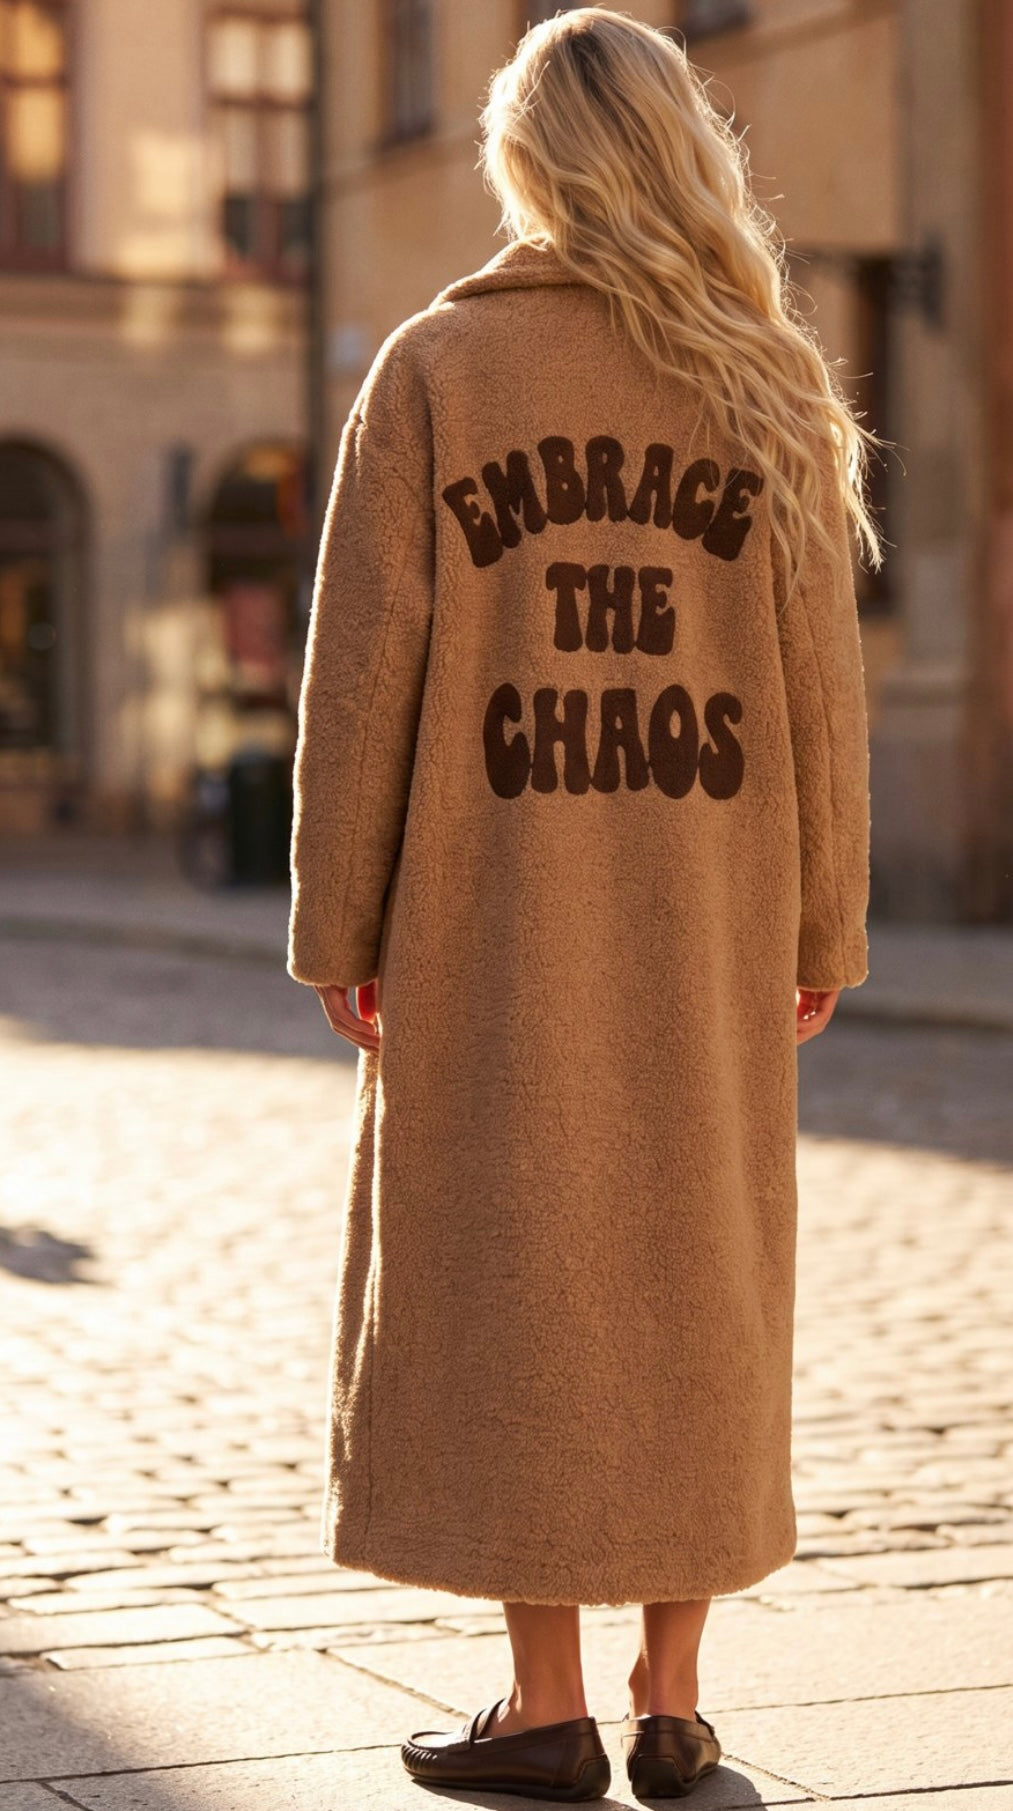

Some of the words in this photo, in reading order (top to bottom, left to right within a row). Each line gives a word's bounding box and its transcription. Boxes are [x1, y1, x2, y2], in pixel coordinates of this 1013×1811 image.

[442, 435, 764, 568] EMBRACE
[546, 561, 676, 656] THE
[483, 682, 745, 800] CHAOS
